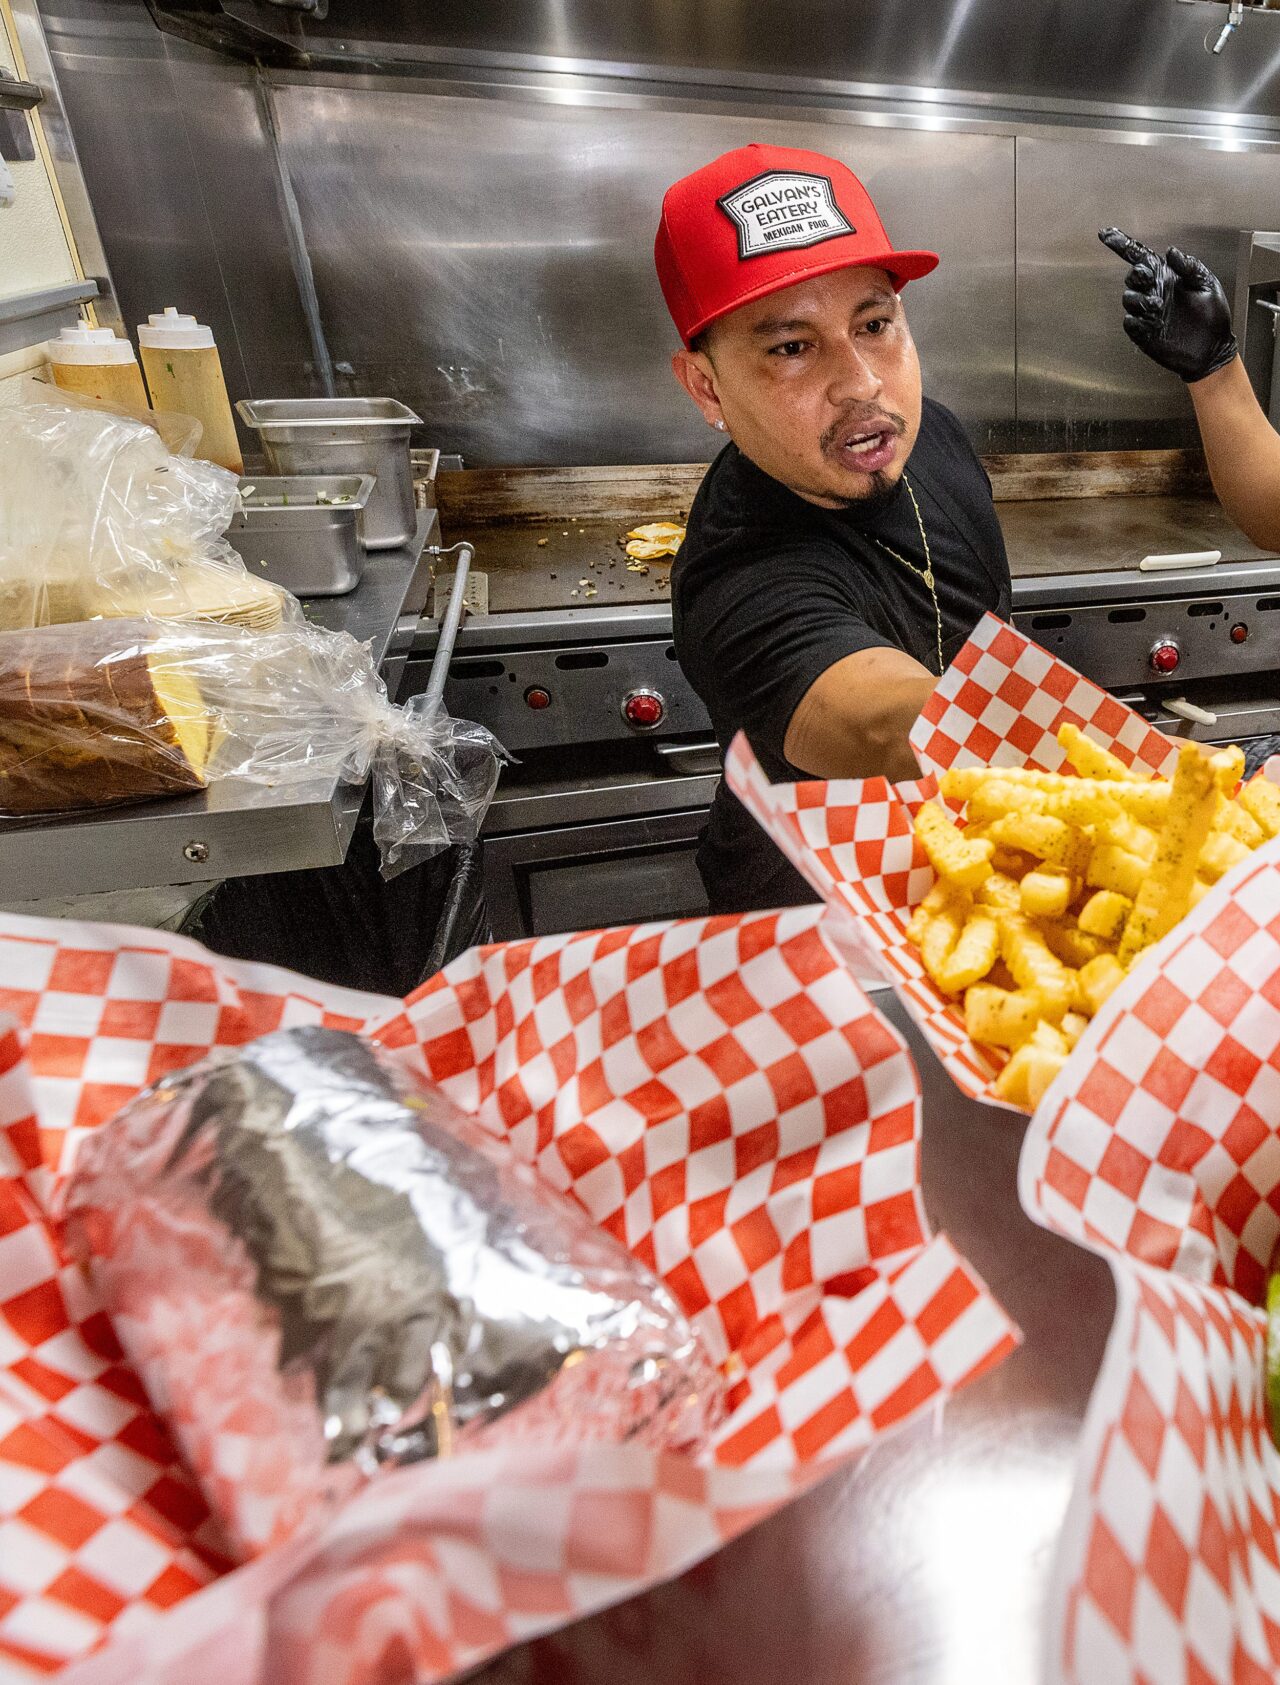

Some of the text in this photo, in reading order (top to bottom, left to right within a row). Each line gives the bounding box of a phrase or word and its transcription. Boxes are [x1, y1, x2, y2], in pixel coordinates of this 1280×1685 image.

[741, 186, 821, 213] GALVAN'S
[756, 201, 818, 226] EATERY
[763, 219, 829, 242] MEXICAN FOOD
